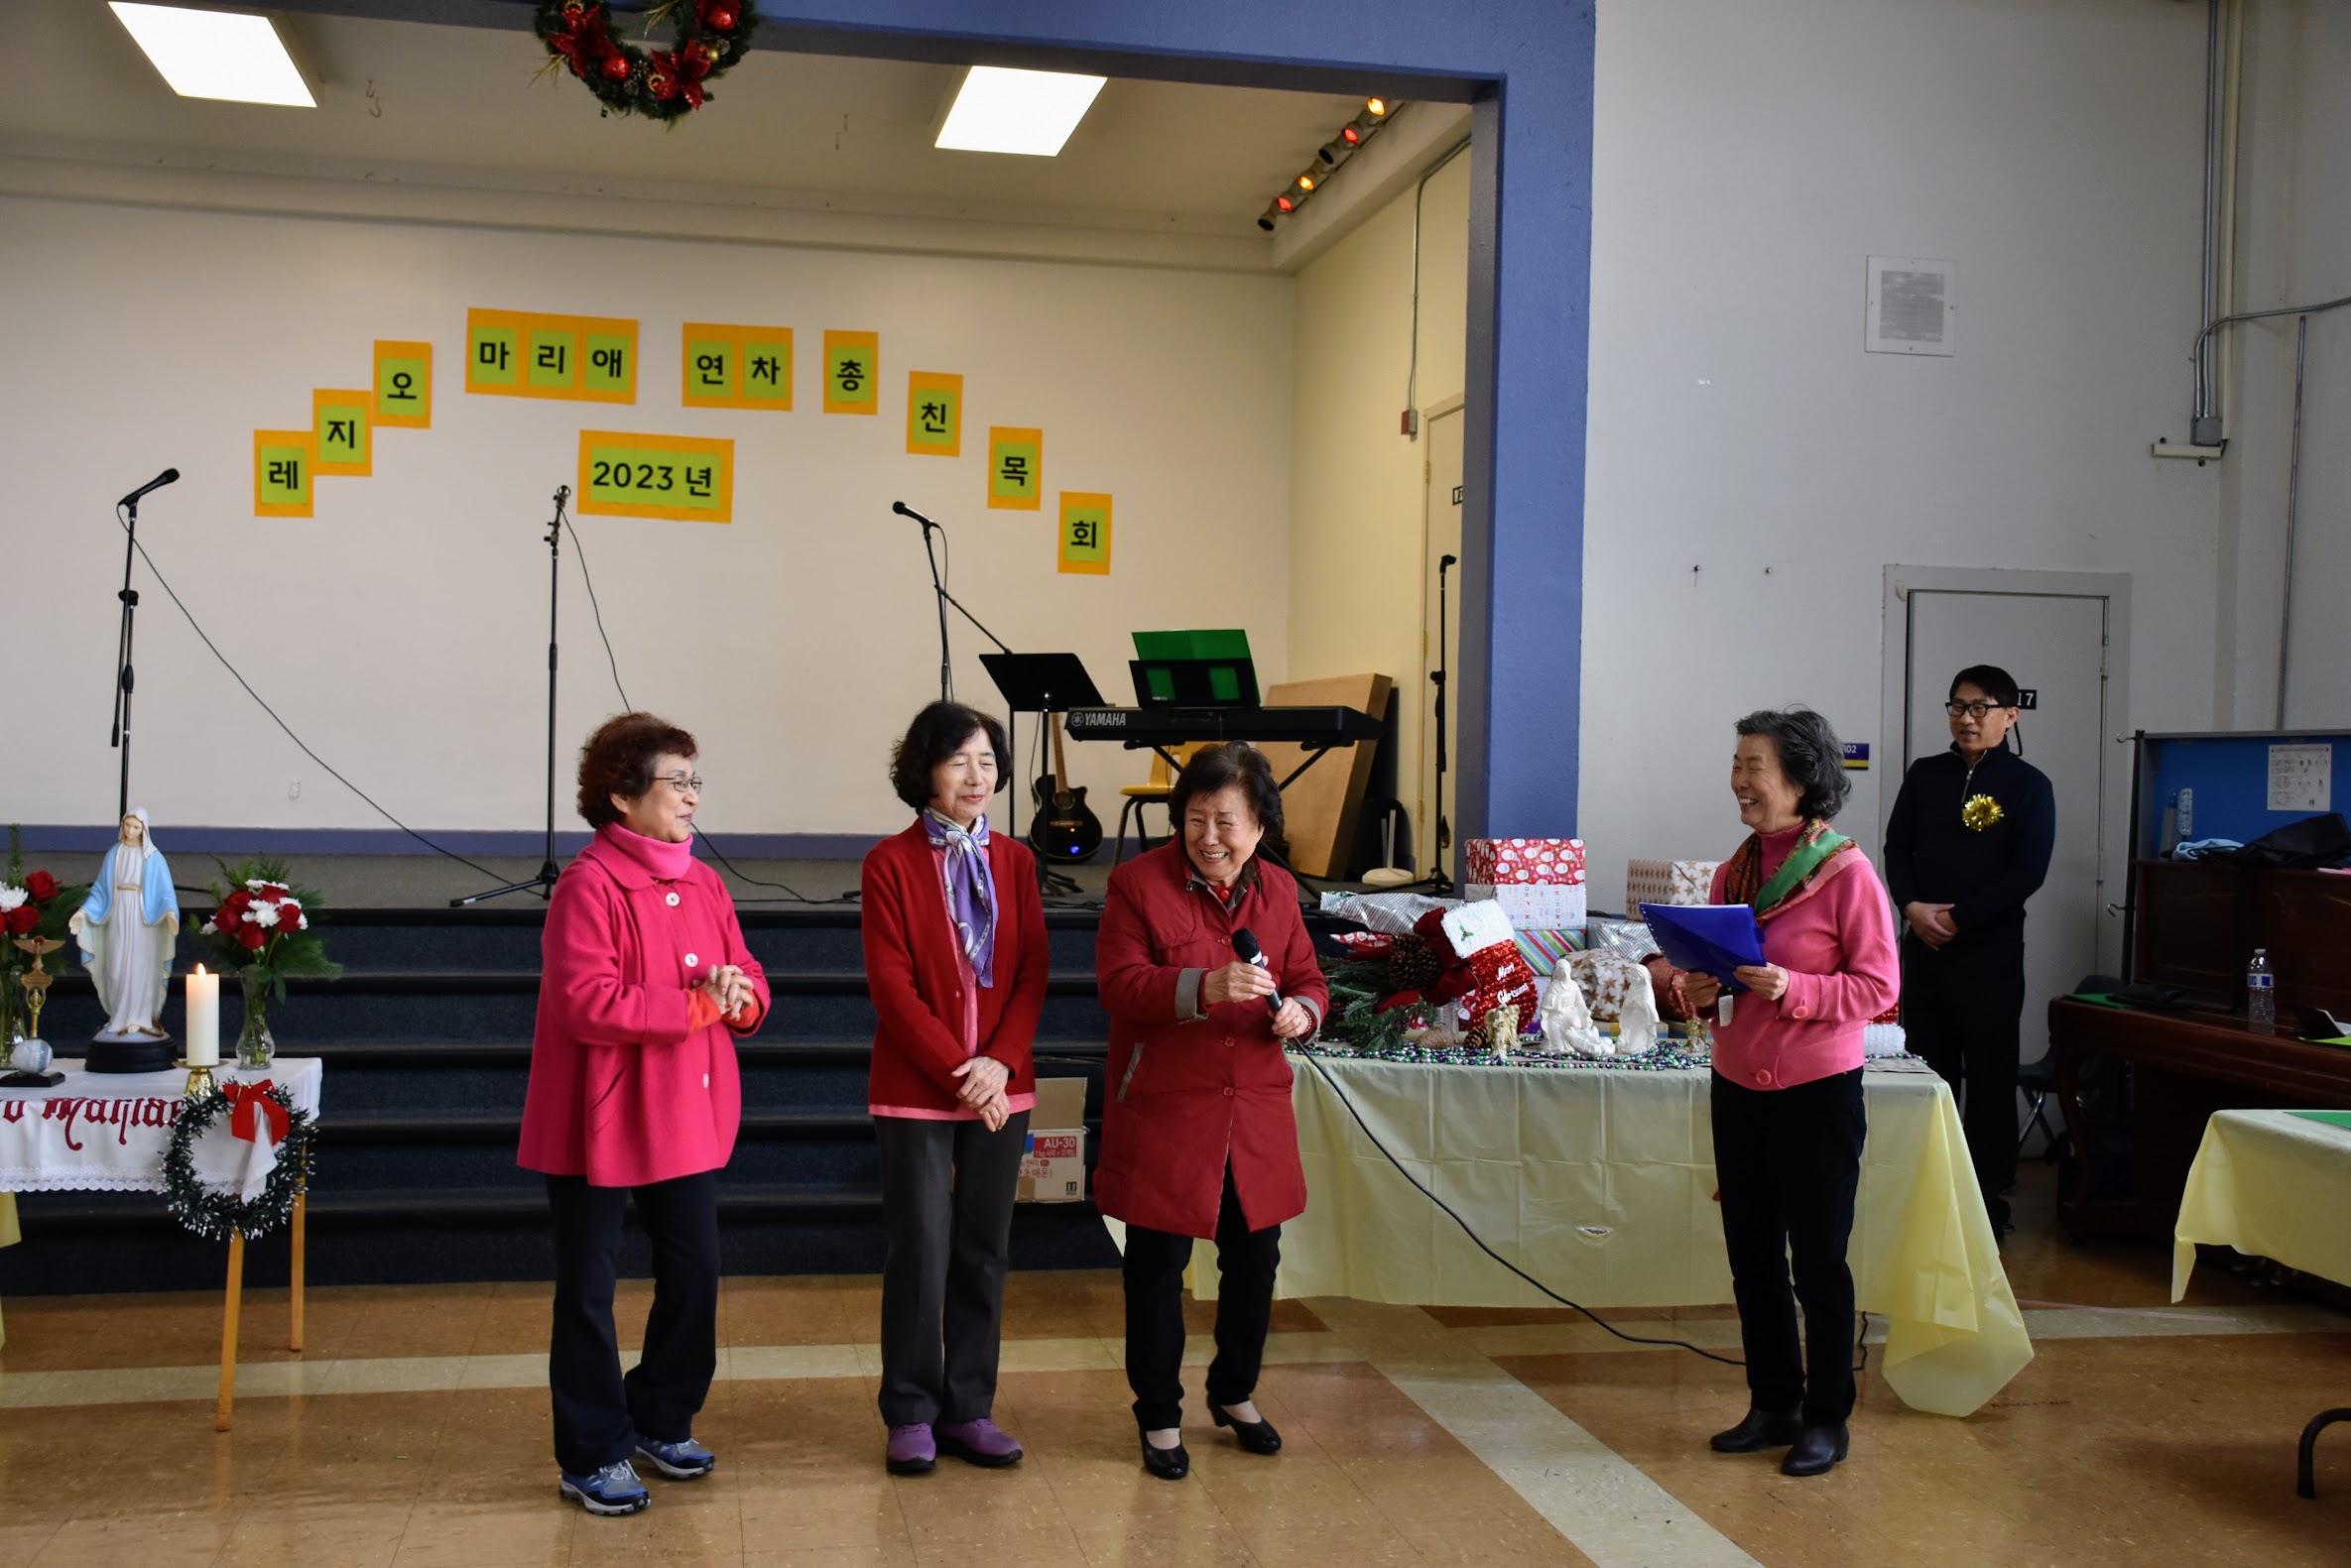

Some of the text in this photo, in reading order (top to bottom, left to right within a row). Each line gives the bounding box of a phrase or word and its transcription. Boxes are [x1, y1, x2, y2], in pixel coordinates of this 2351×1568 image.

[593, 461, 675, 491] 2023
[2017, 691, 2035, 706] 17
[1084, 712, 1126, 726] YAMAHA
[1044, 1138, 1075, 1148] AU-30
